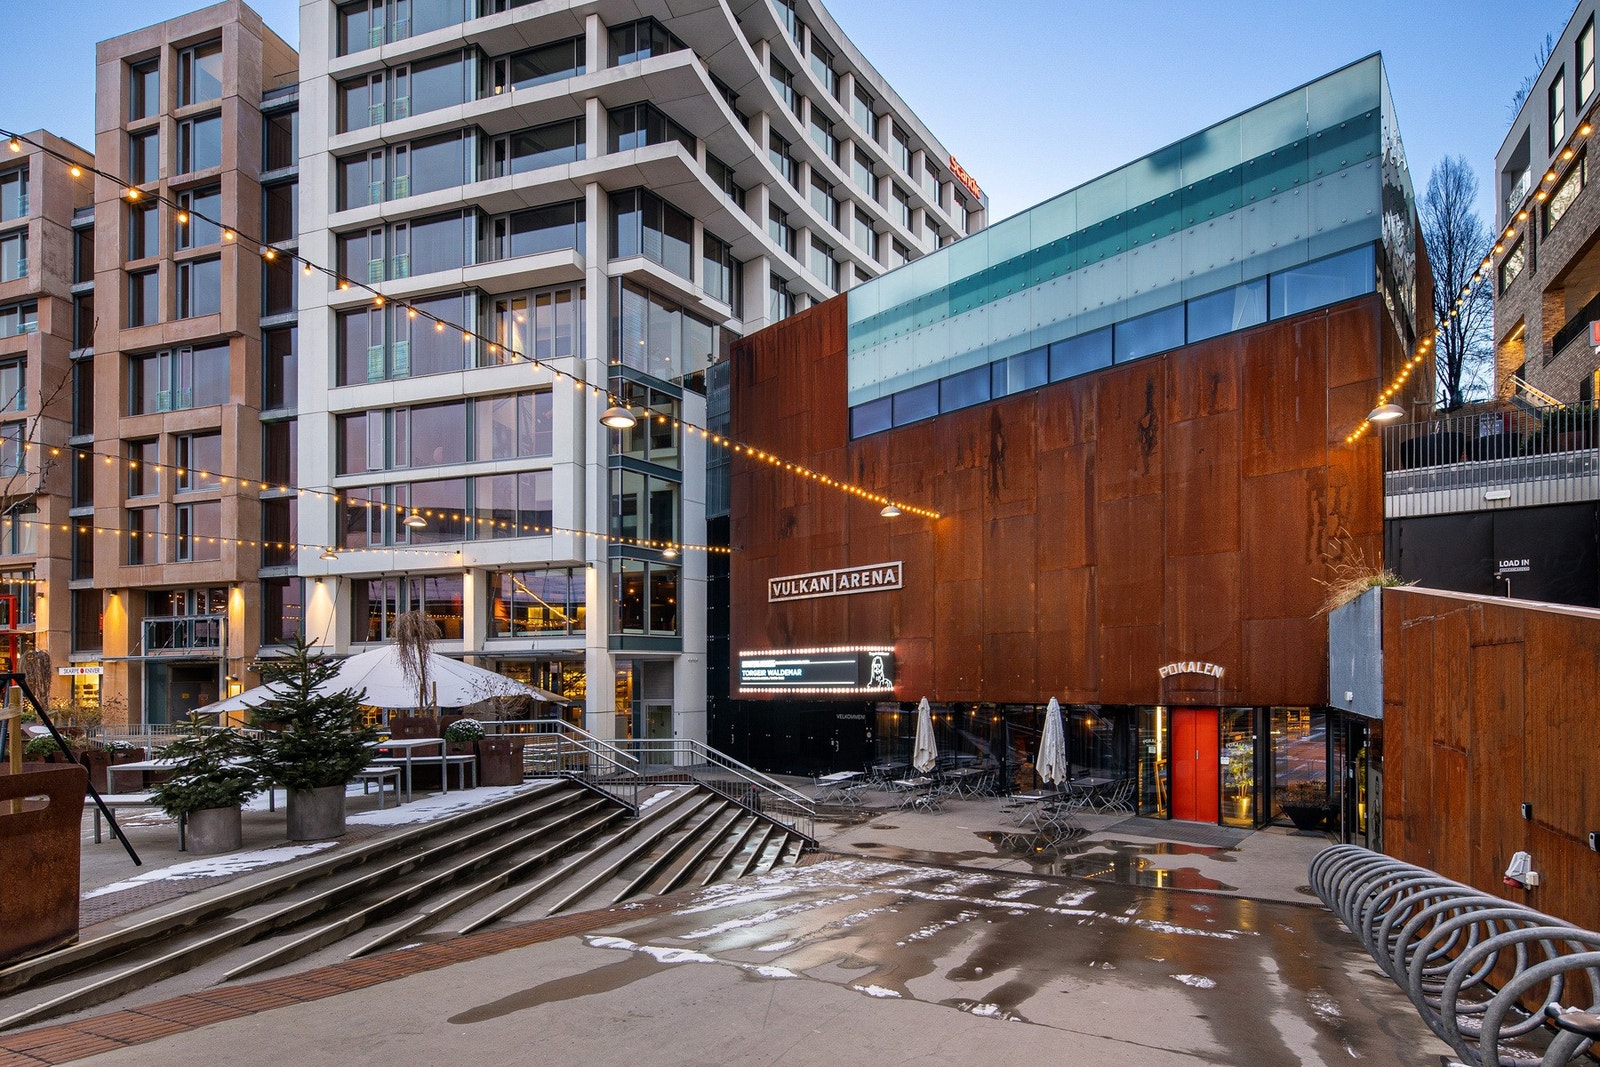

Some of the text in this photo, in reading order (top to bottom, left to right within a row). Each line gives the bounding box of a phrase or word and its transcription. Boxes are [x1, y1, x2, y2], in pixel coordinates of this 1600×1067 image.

[1521, 558, 1530, 566] IN
[772, 568, 896, 597] VULKAN ARENA
[767, 668, 803, 677] WALDEMAR
[1159, 661, 1223, 679] POKALEN
